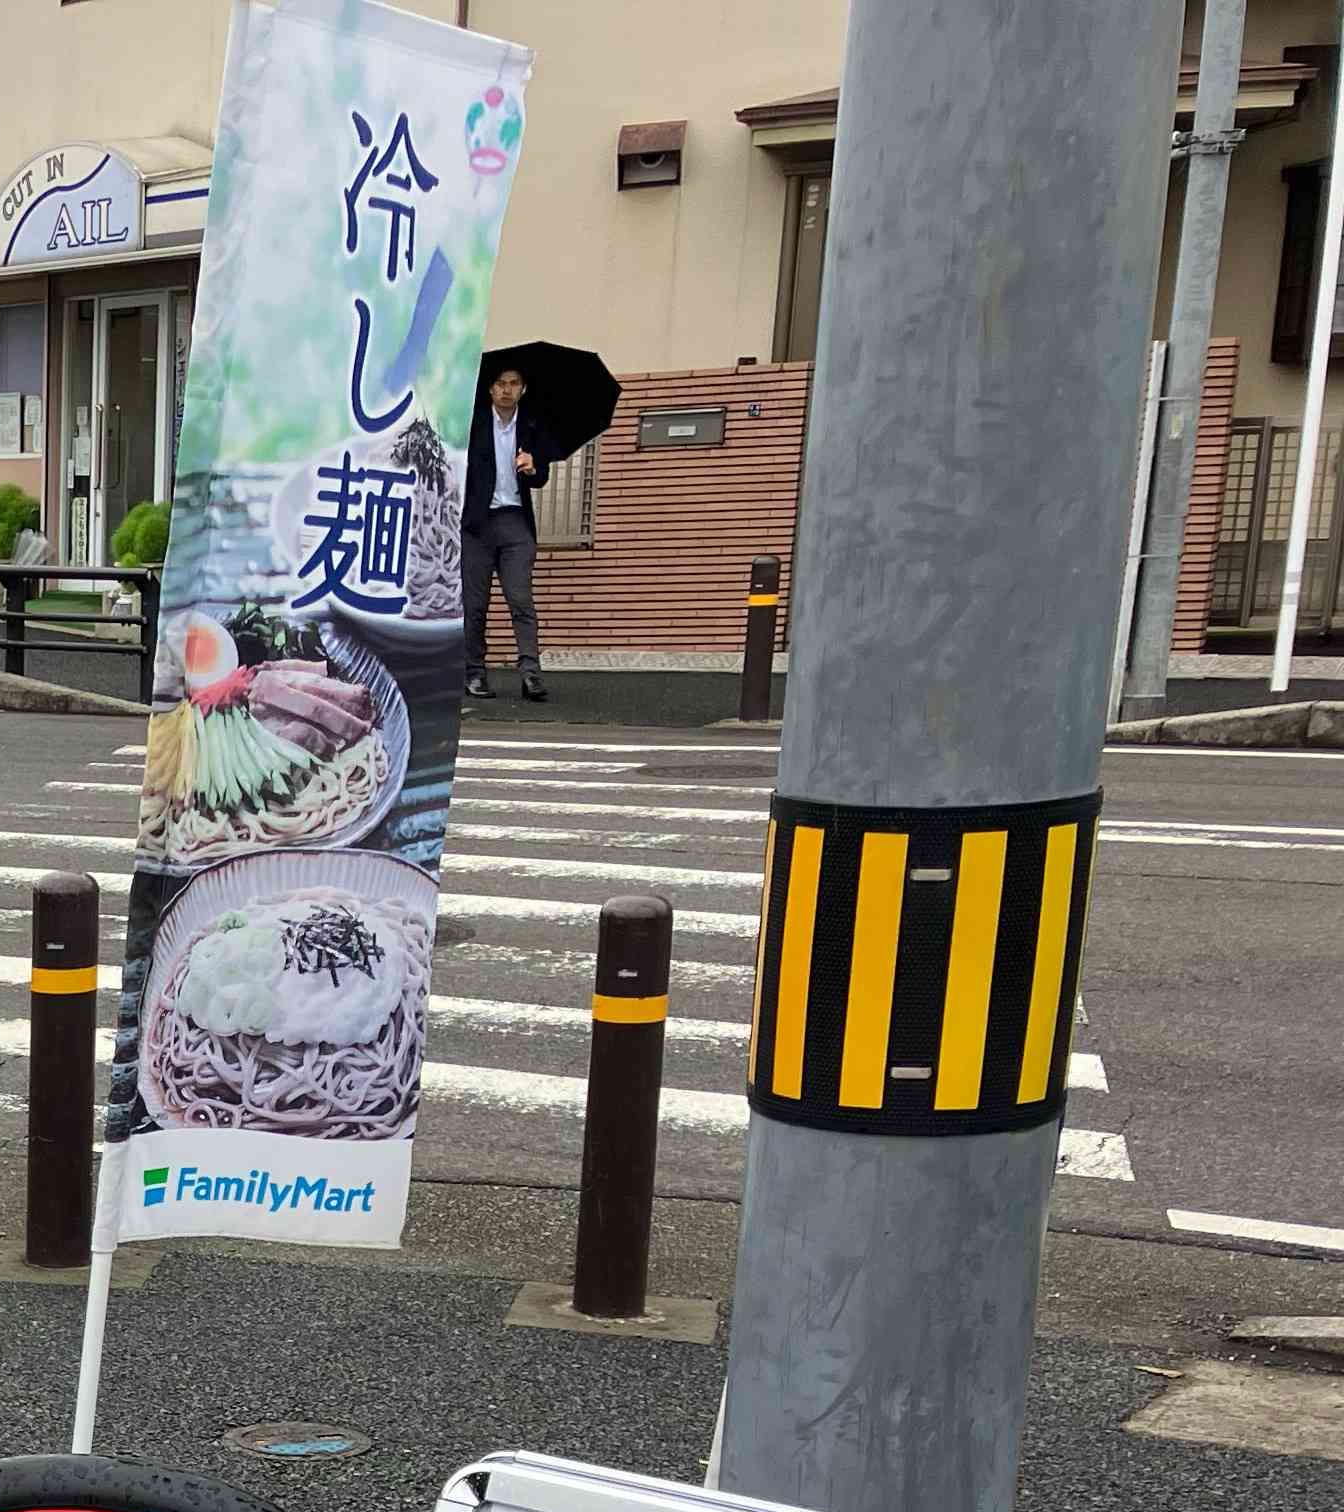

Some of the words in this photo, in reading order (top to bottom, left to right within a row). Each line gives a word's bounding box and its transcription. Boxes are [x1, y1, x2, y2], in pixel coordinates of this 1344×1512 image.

[2, 170, 33, 221] CUT
[46, 153, 64, 182] IN
[47, 198, 128, 250] AIL
[291, 110, 440, 615] 冷し麺
[176, 1167, 375, 1212] FamilyMart
